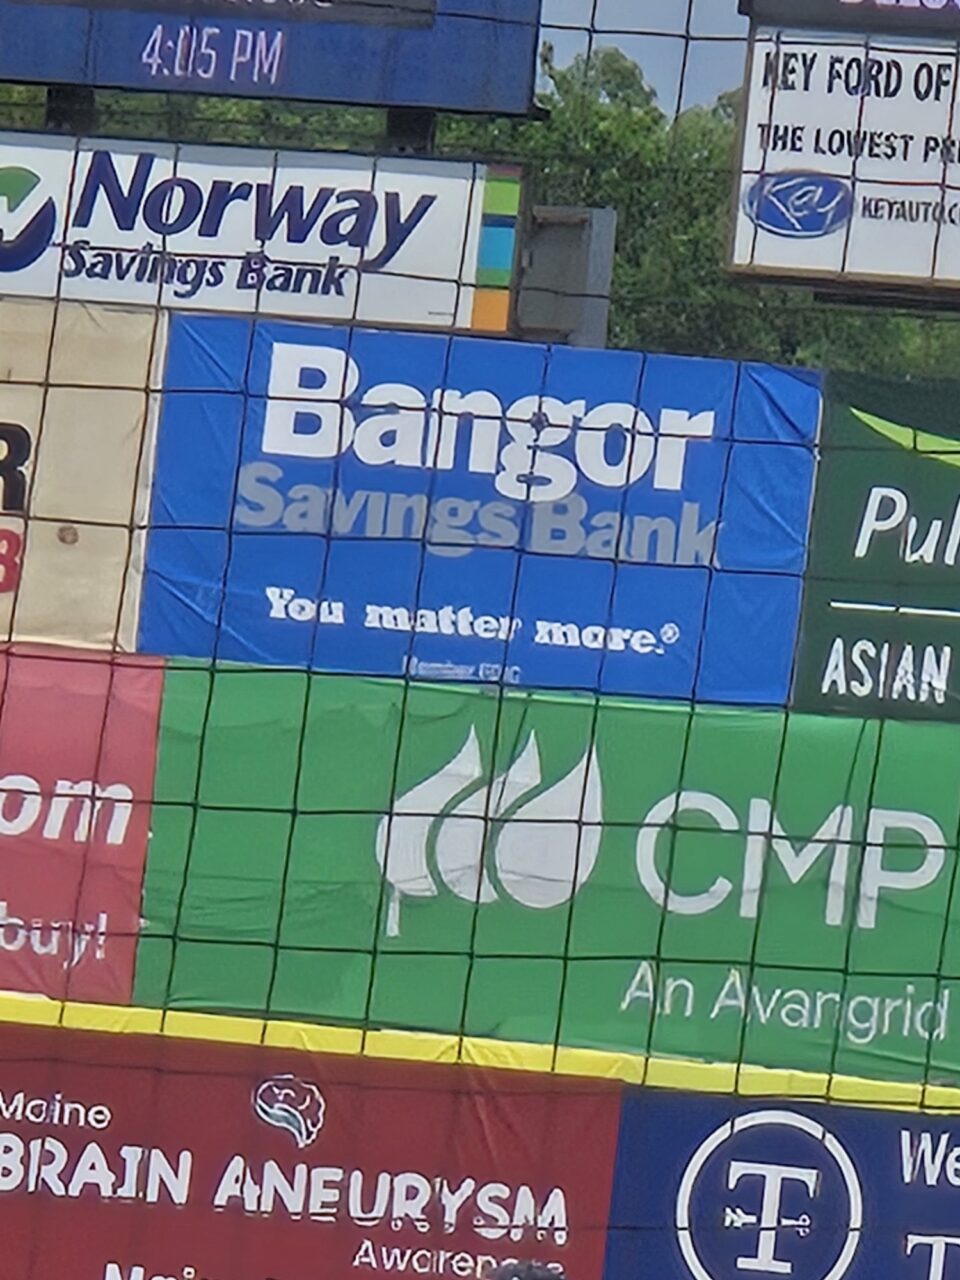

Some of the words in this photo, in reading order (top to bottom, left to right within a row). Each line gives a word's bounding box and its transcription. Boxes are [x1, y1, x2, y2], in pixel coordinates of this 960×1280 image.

[230, 28, 285, 84] PM
[762, 52, 818, 93] KEY
[827, 56, 902, 98] FORD
[914, 61, 952, 103] OF
[758, 122, 804, 153] THE
[813, 126, 915, 163] LOWEST
[73, 150, 437, 270] Norway
[64, 239, 226, 298] Savings
[237, 252, 350, 297] Bank
[261, 342, 715, 504] Bangor
[234, 461, 519, 557] Savings
[532, 494, 725, 569] Bank
[265, 587, 344, 625] You
[365, 603, 522, 641] matter
[821, 637, 950, 705] ASIAN
[636, 790, 946, 929] CMP
[621, 960, 694, 1017] An
[710, 968, 950, 1044] Avangrid
[0, 1132, 193, 1206] BRAIN
[214, 1155, 569, 1246] ANEURYSM
[353, 1239, 565, 1277] Awaren
